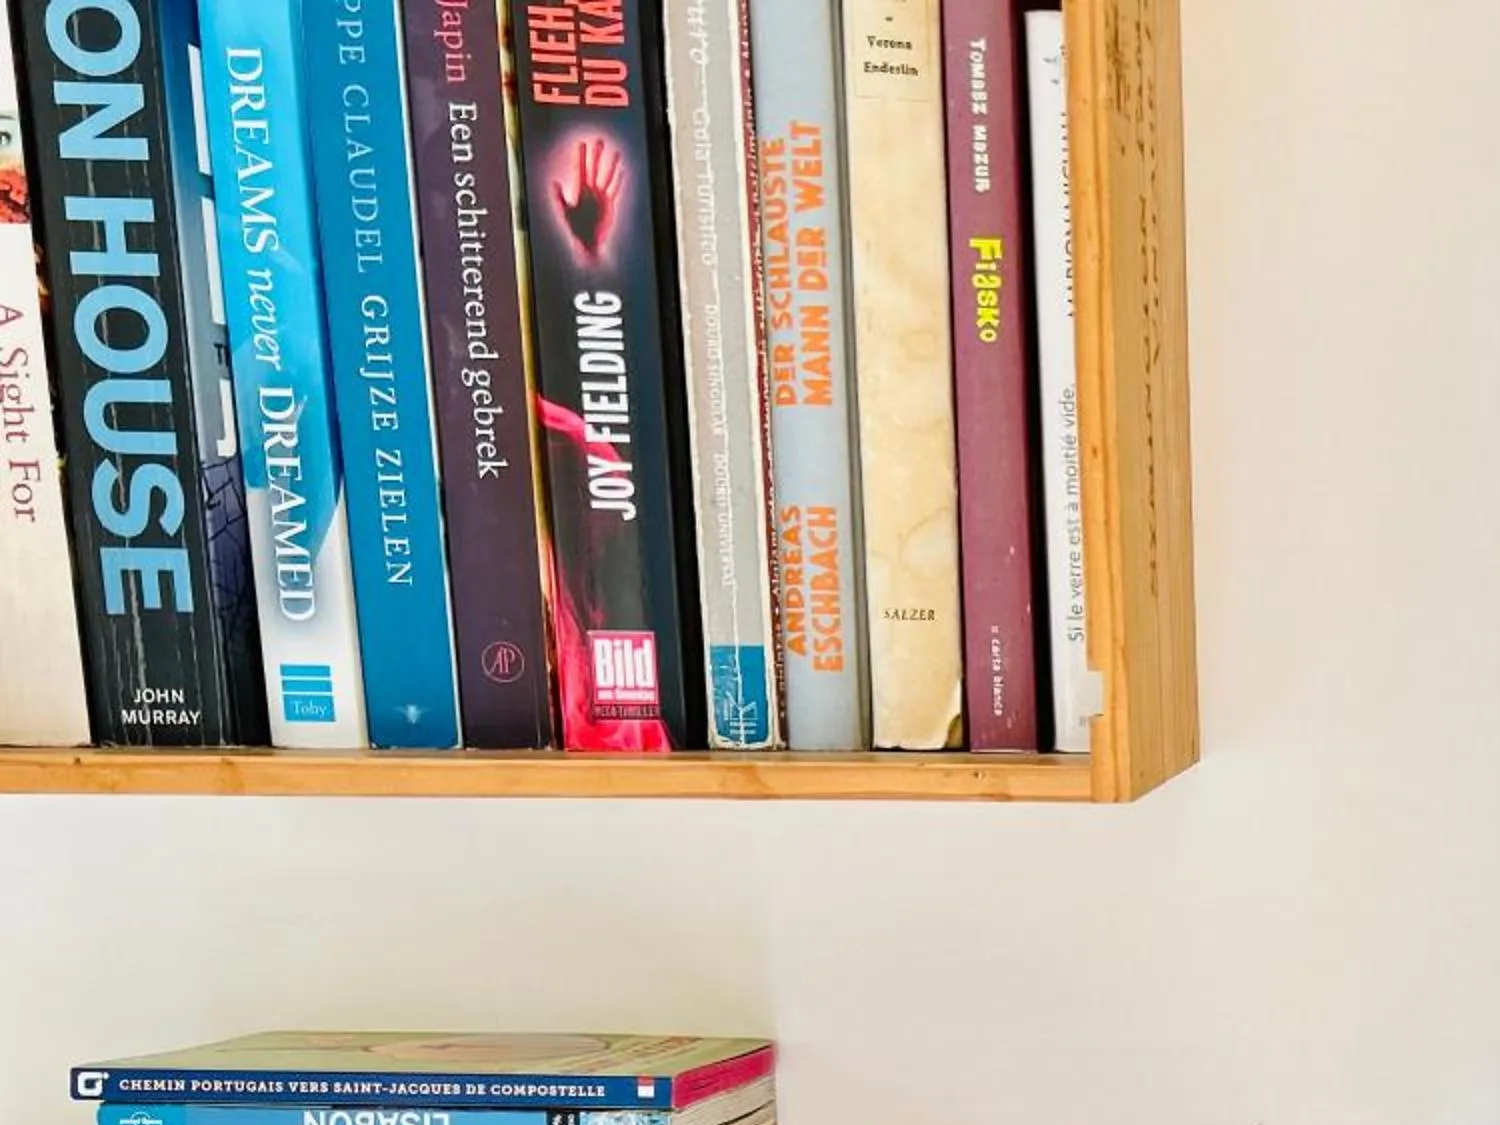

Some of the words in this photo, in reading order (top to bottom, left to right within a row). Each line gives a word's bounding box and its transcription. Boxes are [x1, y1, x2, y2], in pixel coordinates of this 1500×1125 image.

[433, 0, 471, 84] Japin
[225, 46, 281, 253] DREAMS
[343, 84, 385, 274] CLAUDEL
[448, 101, 479, 164] Een
[789, 121, 824, 228] WELT
[455, 173, 499, 361] schitterend
[760, 136, 791, 331] SCHLAUSTE
[794, 237, 829, 295] DER
[245, 267, 282, 371] never
[361, 295, 400, 432] GRIJZE
[573, 290, 632, 442] FIELDING
[798, 304, 834, 407] MANN
[64, 196, 195, 615] HOUSE
[461, 368, 510, 480] gebrek
[770, 343, 799, 407] DER
[258, 387, 316, 622] DREAMED
[376, 448, 413, 587] ZIELEN
[590, 446, 637, 522] JOY
[1064, 453, 1081, 497] moitié
[778, 504, 806, 656] ANDREAS
[1067, 514, 1082, 549] est
[1068, 553, 1083, 596] verre
[799, 506, 844, 673] ESCHBACH
[1066, 598, 1082, 617] le
[1066, 618, 1082, 642] Si
[134, 688, 185, 705] JOHN
[592, 637, 656, 690] Bild
[121, 708, 201, 727] MURRAY
[119, 1079, 185, 1092] CHEMIN
[191, 1080, 285, 1094] PORTUGAIS
[288, 1081, 330, 1094] VERS
[333, 1082, 461, 1096] SAINT-JACQUES
[465, 1083, 488, 1096] DE
[490, 1084, 606, 1098] COMPOSTELLE
